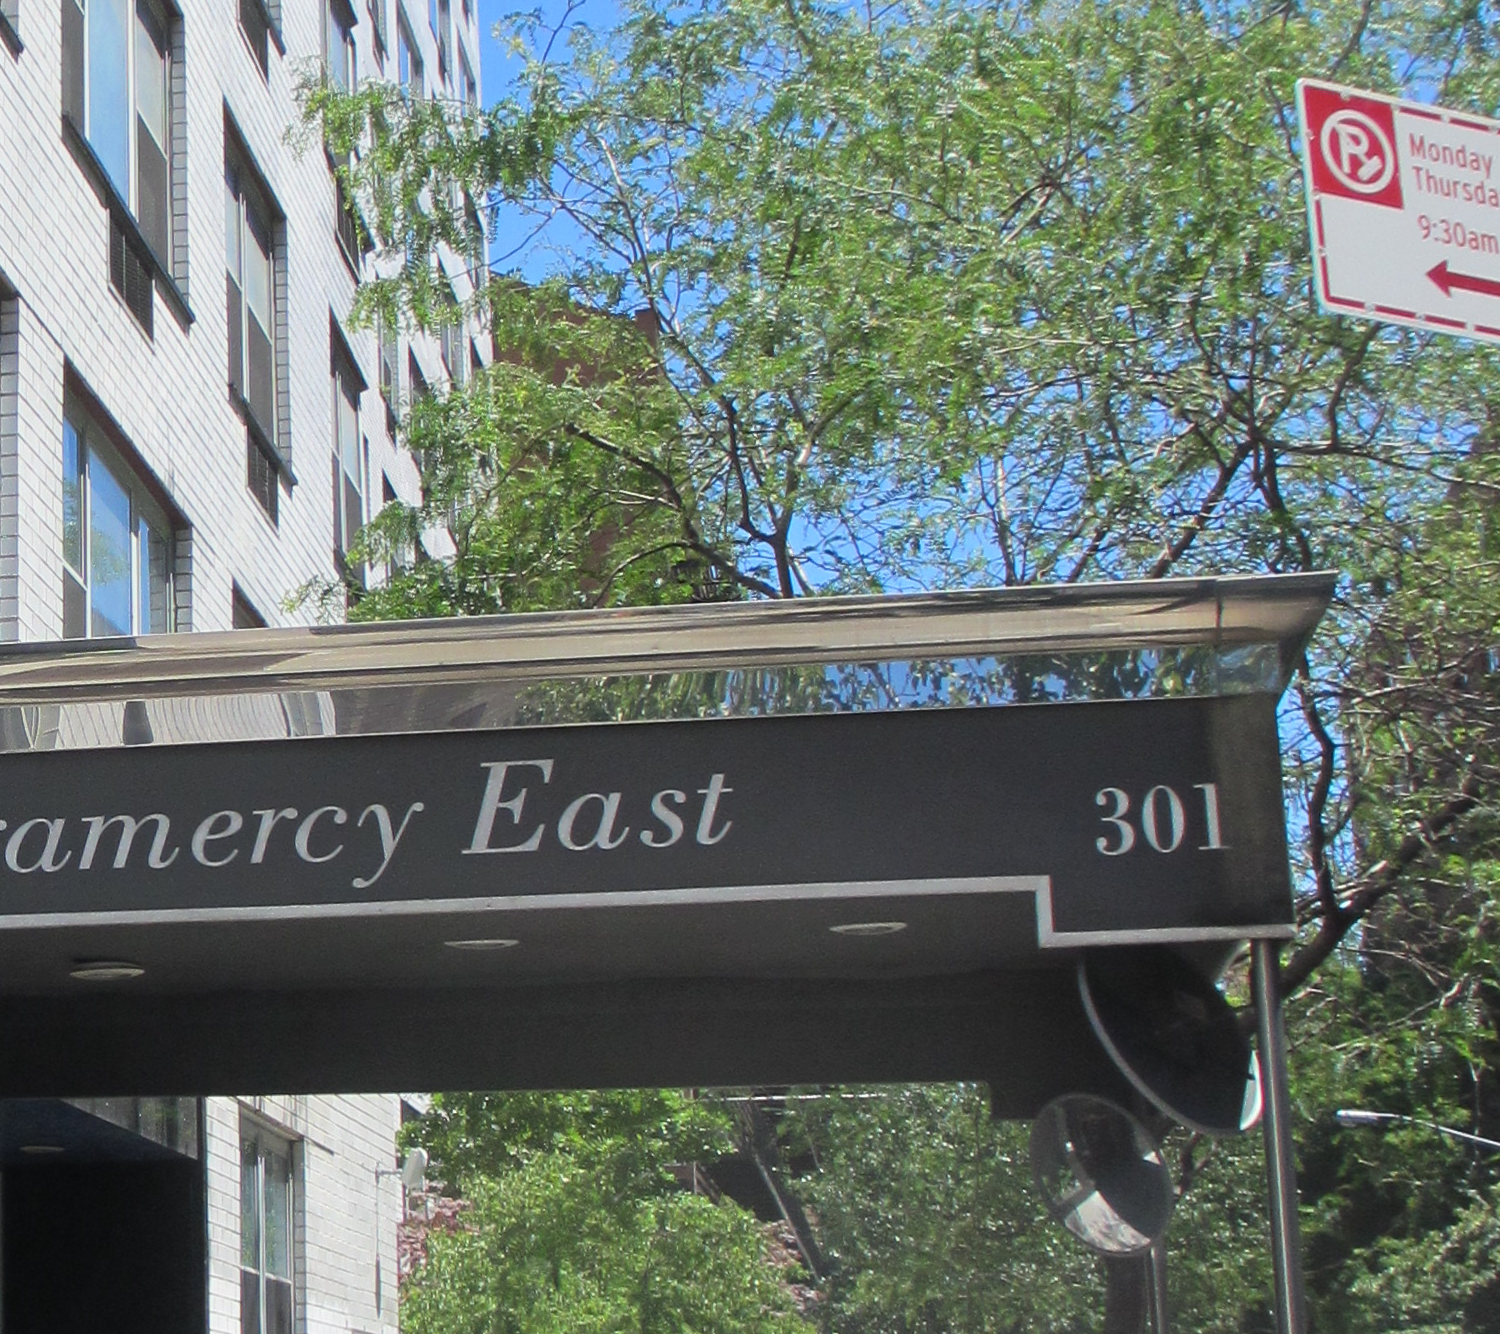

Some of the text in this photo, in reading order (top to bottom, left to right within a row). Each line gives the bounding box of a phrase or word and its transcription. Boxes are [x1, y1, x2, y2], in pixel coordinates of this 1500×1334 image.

[1408, 131, 1493, 179] Monday
[1411, 165, 1500, 208] Thursda
[1417, 214, 1500, 254] 9:30am
[461, 758, 734, 855] East
[1095, 783, 1233, 856] 301
